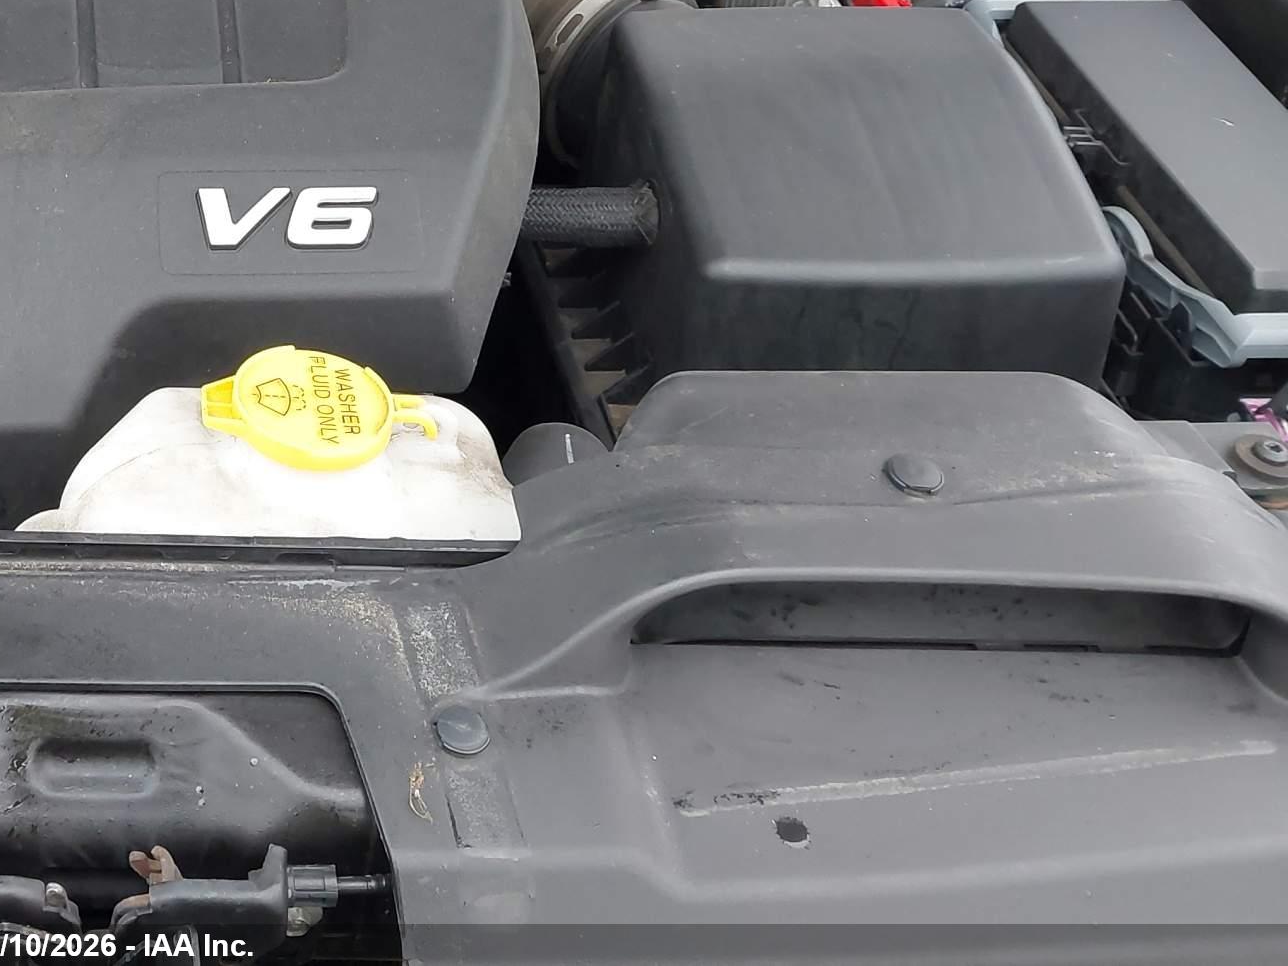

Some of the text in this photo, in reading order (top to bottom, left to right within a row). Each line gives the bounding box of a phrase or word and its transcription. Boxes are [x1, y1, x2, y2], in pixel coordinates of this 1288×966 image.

[196, 186, 378, 250] V6
[308, 355, 340, 446] FLUID ONLY
[333, 367, 361, 436] WASHER
